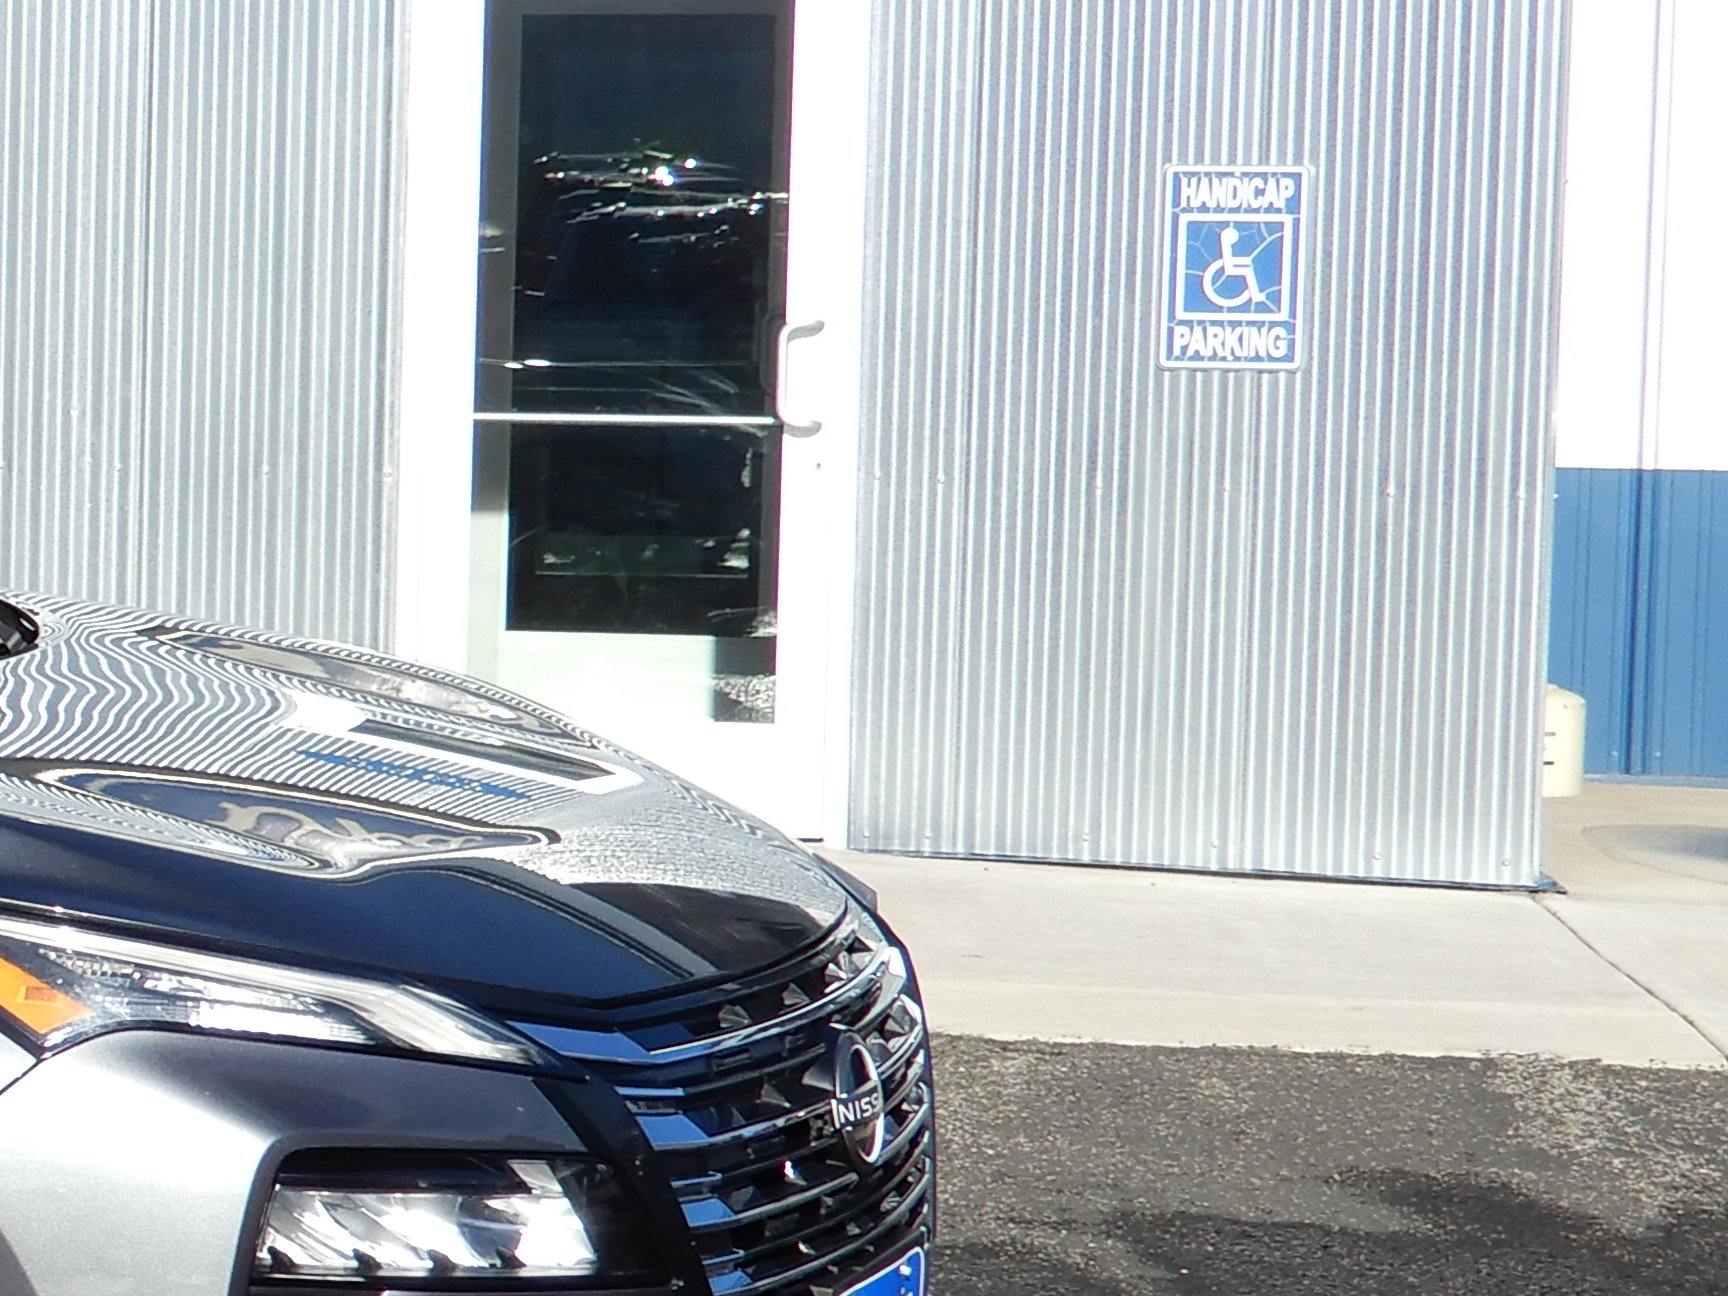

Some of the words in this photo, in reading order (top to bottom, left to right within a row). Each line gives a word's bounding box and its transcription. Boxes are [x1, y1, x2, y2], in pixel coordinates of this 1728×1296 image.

[1180, 176, 1295, 209] HANDICAP
[1173, 325, 1288, 358] PARKING
[838, 1092, 880, 1123] NISS
